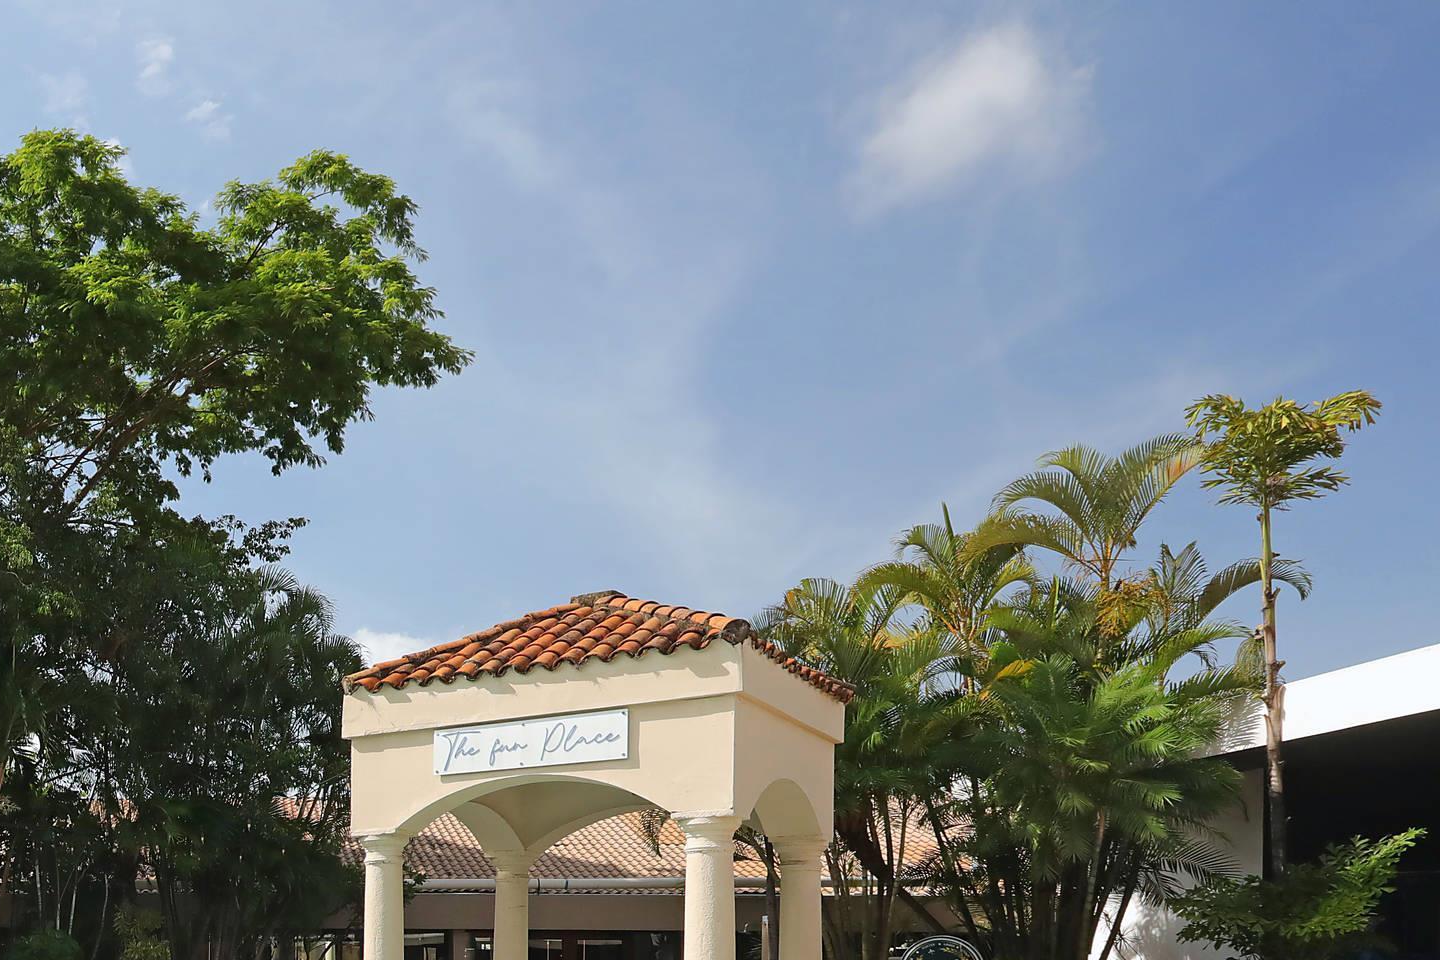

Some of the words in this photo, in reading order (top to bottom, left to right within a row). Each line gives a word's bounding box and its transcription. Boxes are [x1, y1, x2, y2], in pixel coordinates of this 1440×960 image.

[442, 731, 481, 771] The
[489, 738, 528, 767] fun
[540, 722, 621, 761] Place
